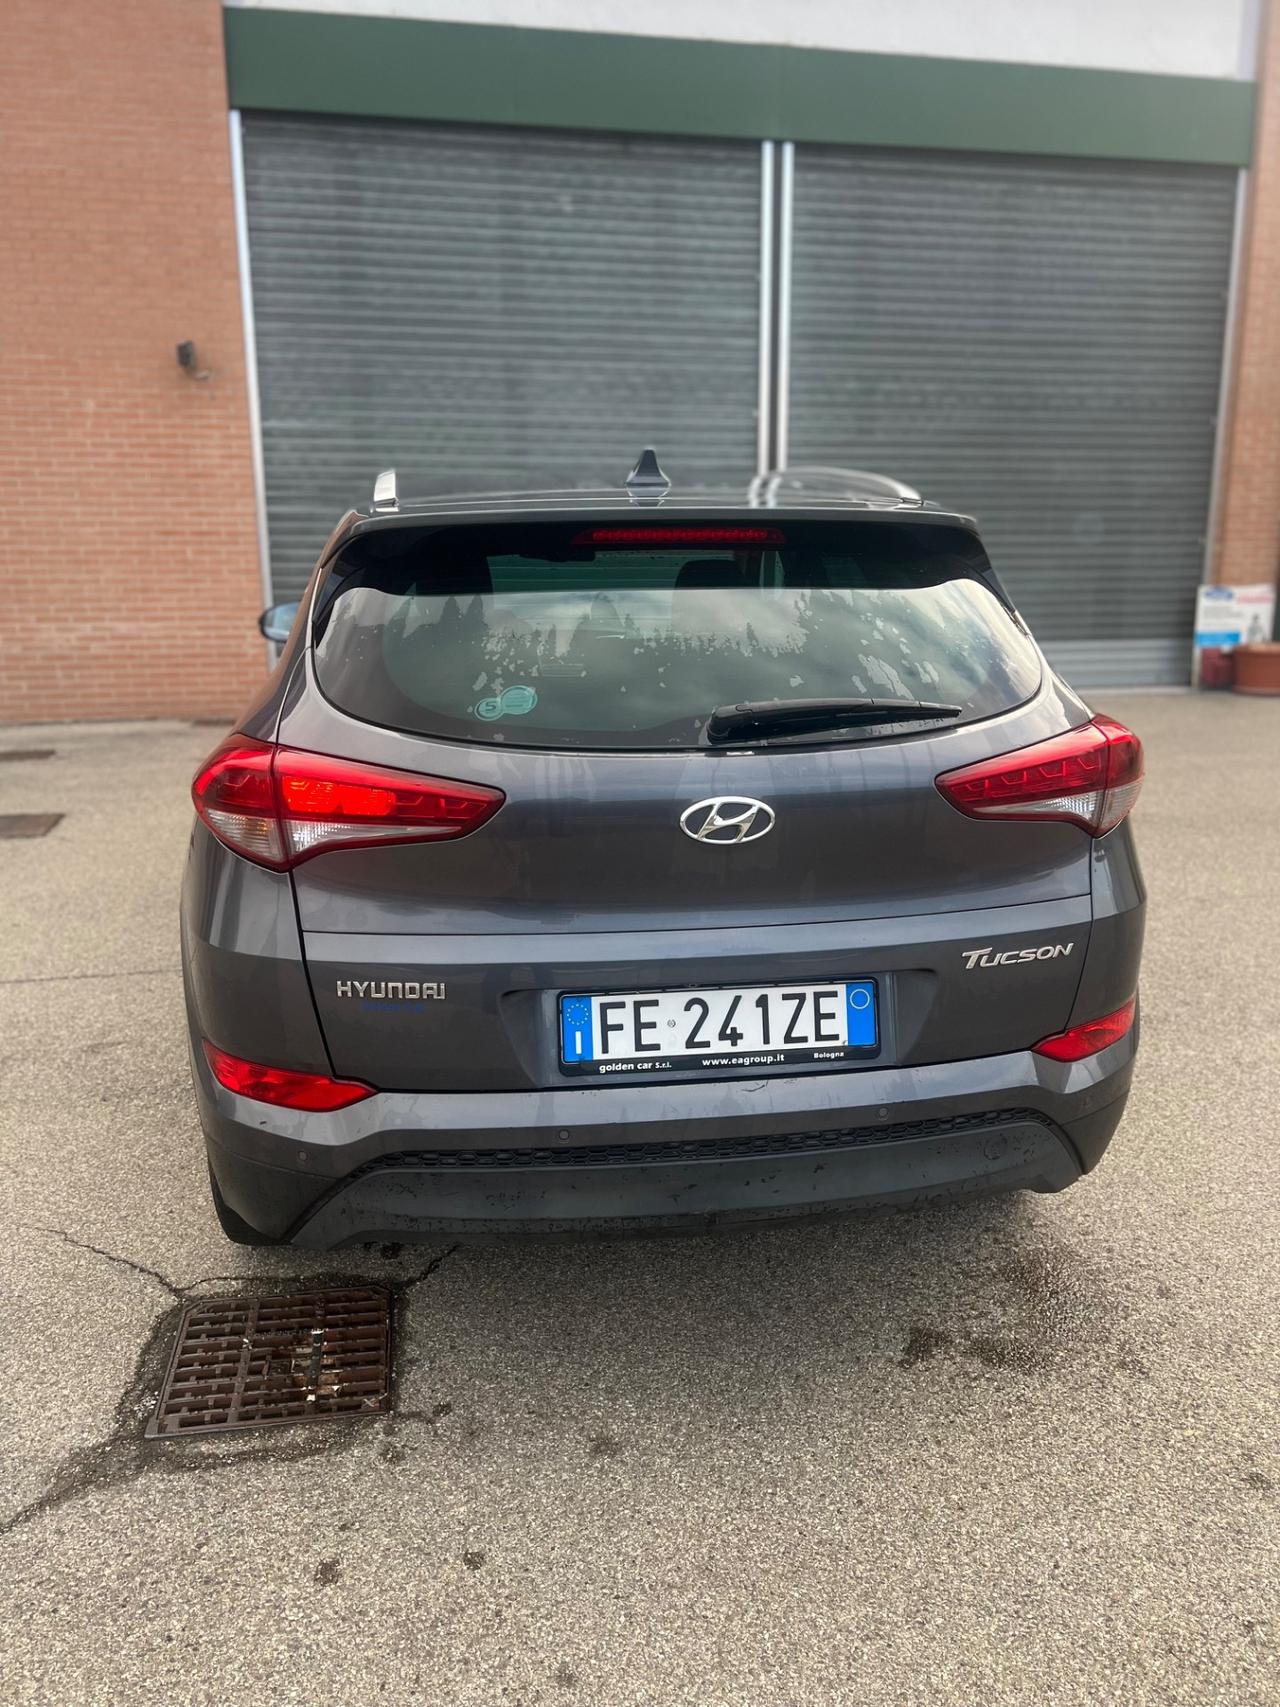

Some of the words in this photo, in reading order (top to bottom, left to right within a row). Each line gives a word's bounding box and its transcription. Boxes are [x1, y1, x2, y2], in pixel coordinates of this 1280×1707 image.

[336, 981, 445, 999] HYUNDAI
[600, 999, 661, 1054] FE
[683, 990, 840, 1049] 241ZE
[702, 1053, 785, 1066] www.eagroup.it
[813, 1051, 845, 1060] Bologna
[599, 1063, 634, 1074] golden
[637, 1062, 653, 1070] car
